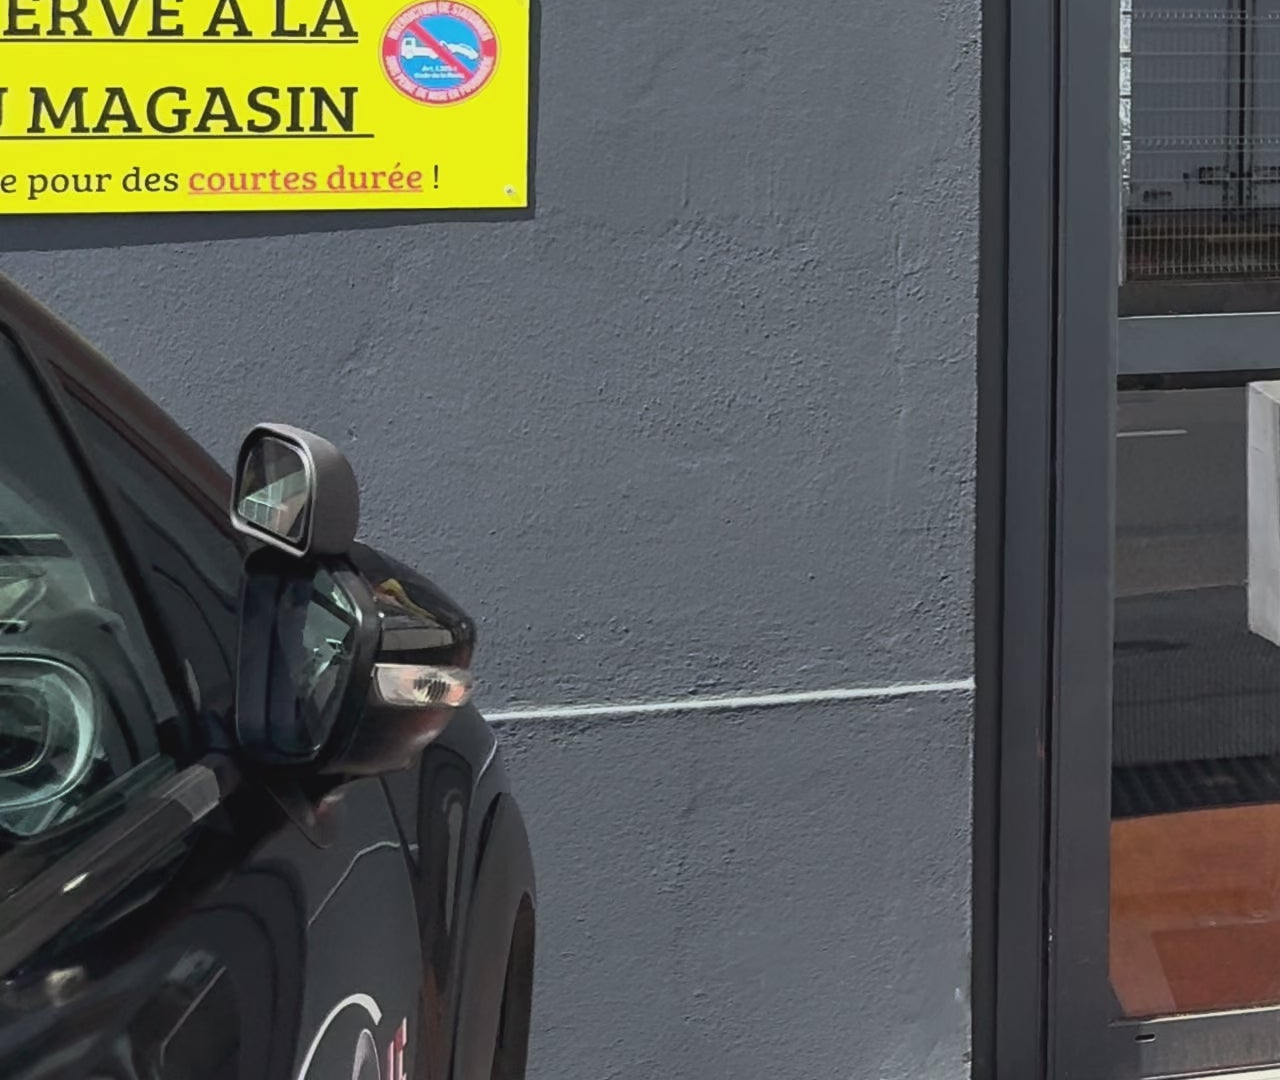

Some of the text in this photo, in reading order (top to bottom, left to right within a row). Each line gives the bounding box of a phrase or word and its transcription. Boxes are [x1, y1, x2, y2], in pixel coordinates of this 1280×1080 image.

[27, 86, 359, 134] MAGASIN
[27, 173, 112, 201] pour
[122, 167, 180, 193] des
[188, 169, 318, 195] courtes
[326, 162, 423, 192] durée
